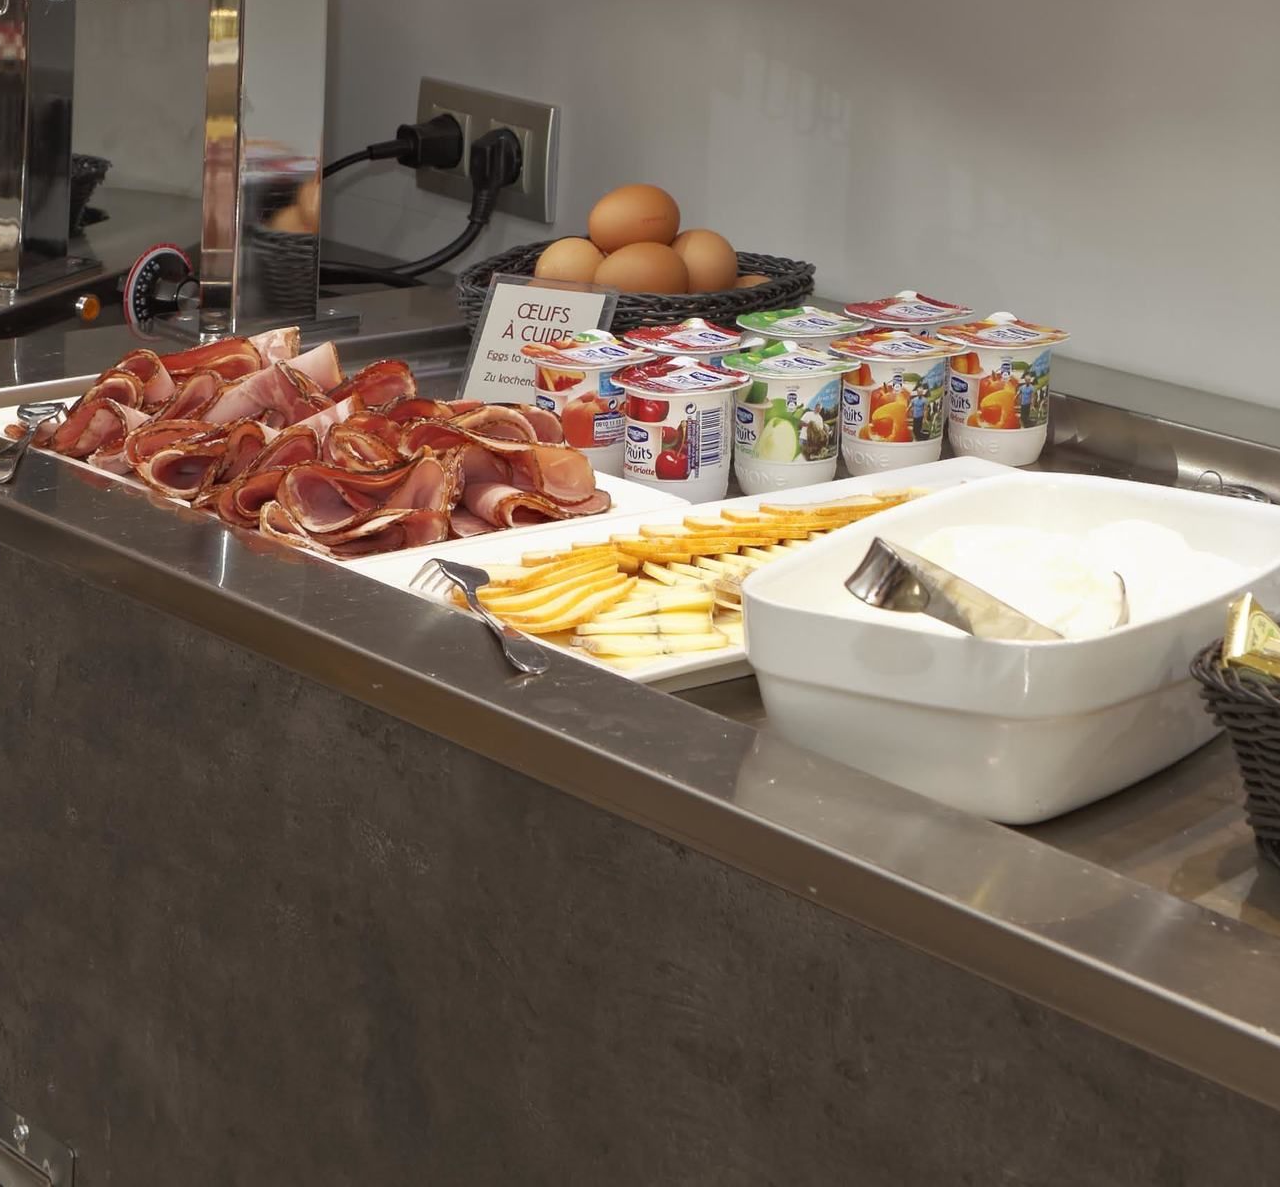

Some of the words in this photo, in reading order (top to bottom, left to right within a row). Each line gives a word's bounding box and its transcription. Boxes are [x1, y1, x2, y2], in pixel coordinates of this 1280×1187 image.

[517, 302, 571, 323] ŒUFS
[502, 319, 515, 340] À
[486, 349, 509, 363] Eggs
[511, 353, 521, 363] to
[483, 371, 496, 382] Zu
